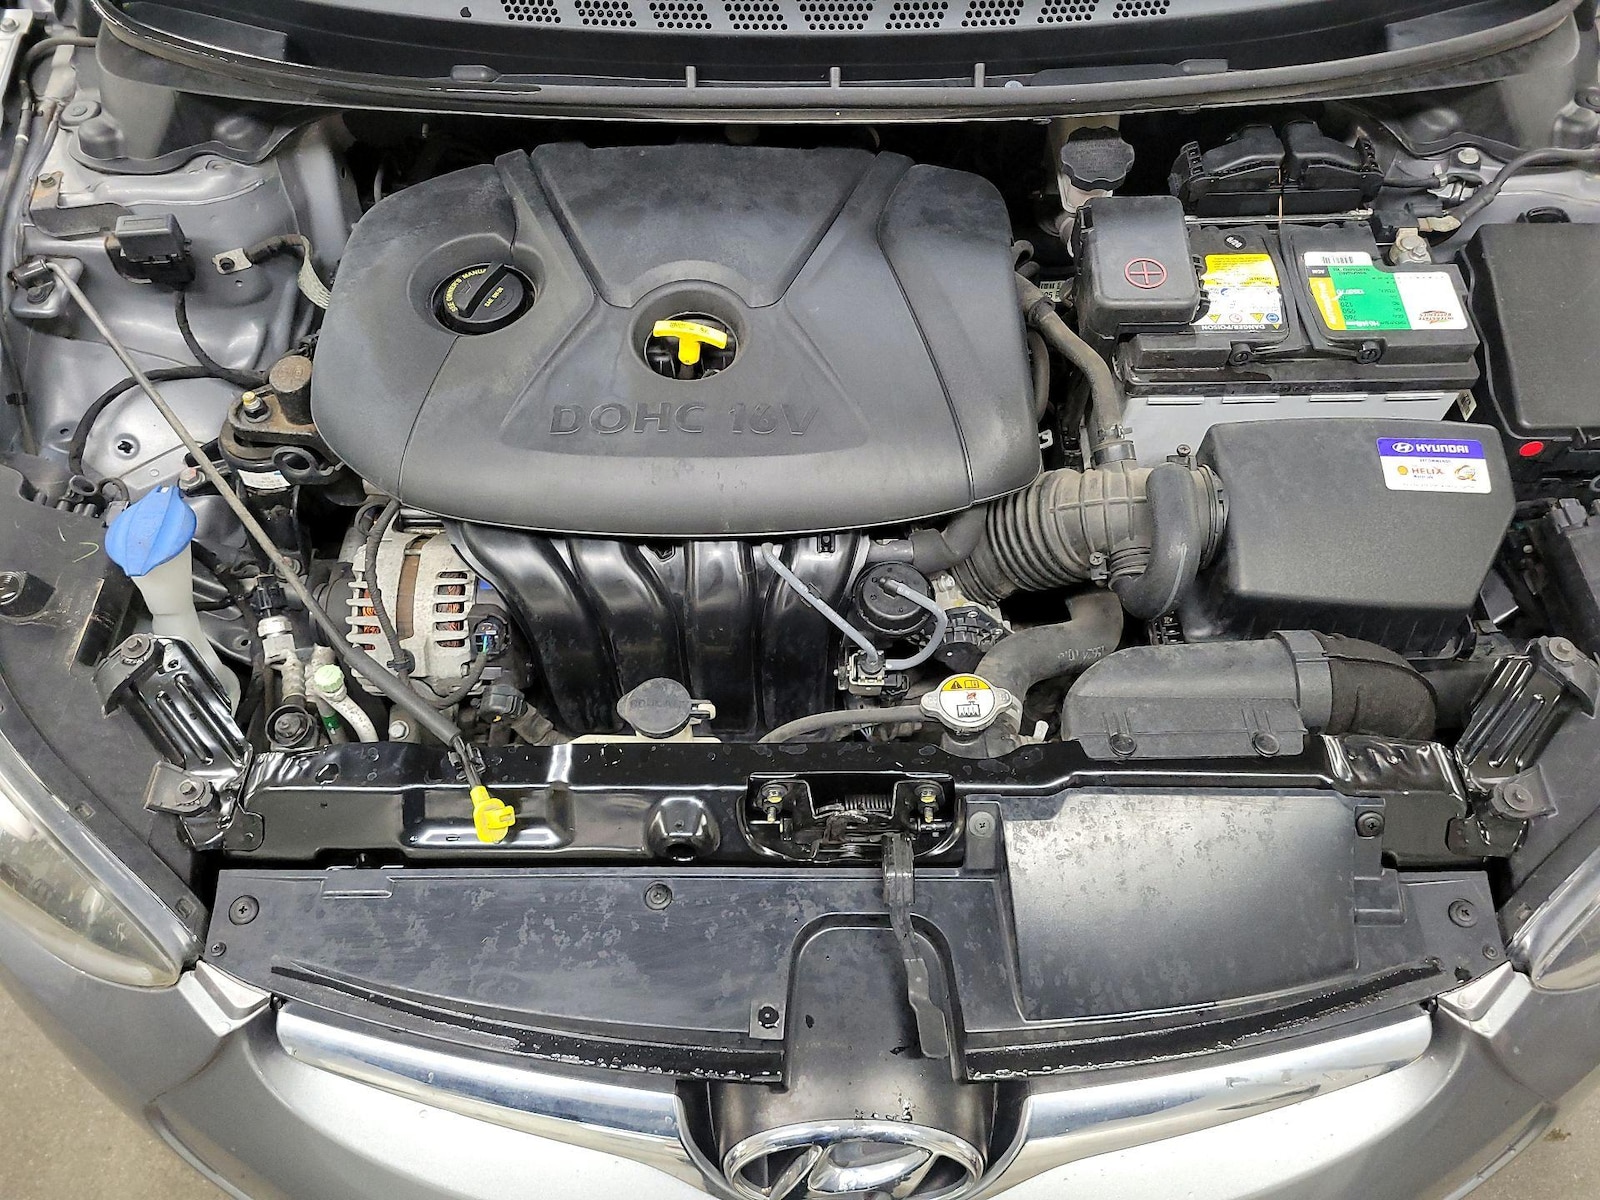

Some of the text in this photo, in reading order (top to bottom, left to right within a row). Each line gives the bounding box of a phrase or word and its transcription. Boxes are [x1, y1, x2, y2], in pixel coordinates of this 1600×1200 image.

[549, 402, 820, 436] DOHC 16V
[1415, 443, 1470, 454] HYUNDAI
[1411, 466, 1445, 475] HELIX
